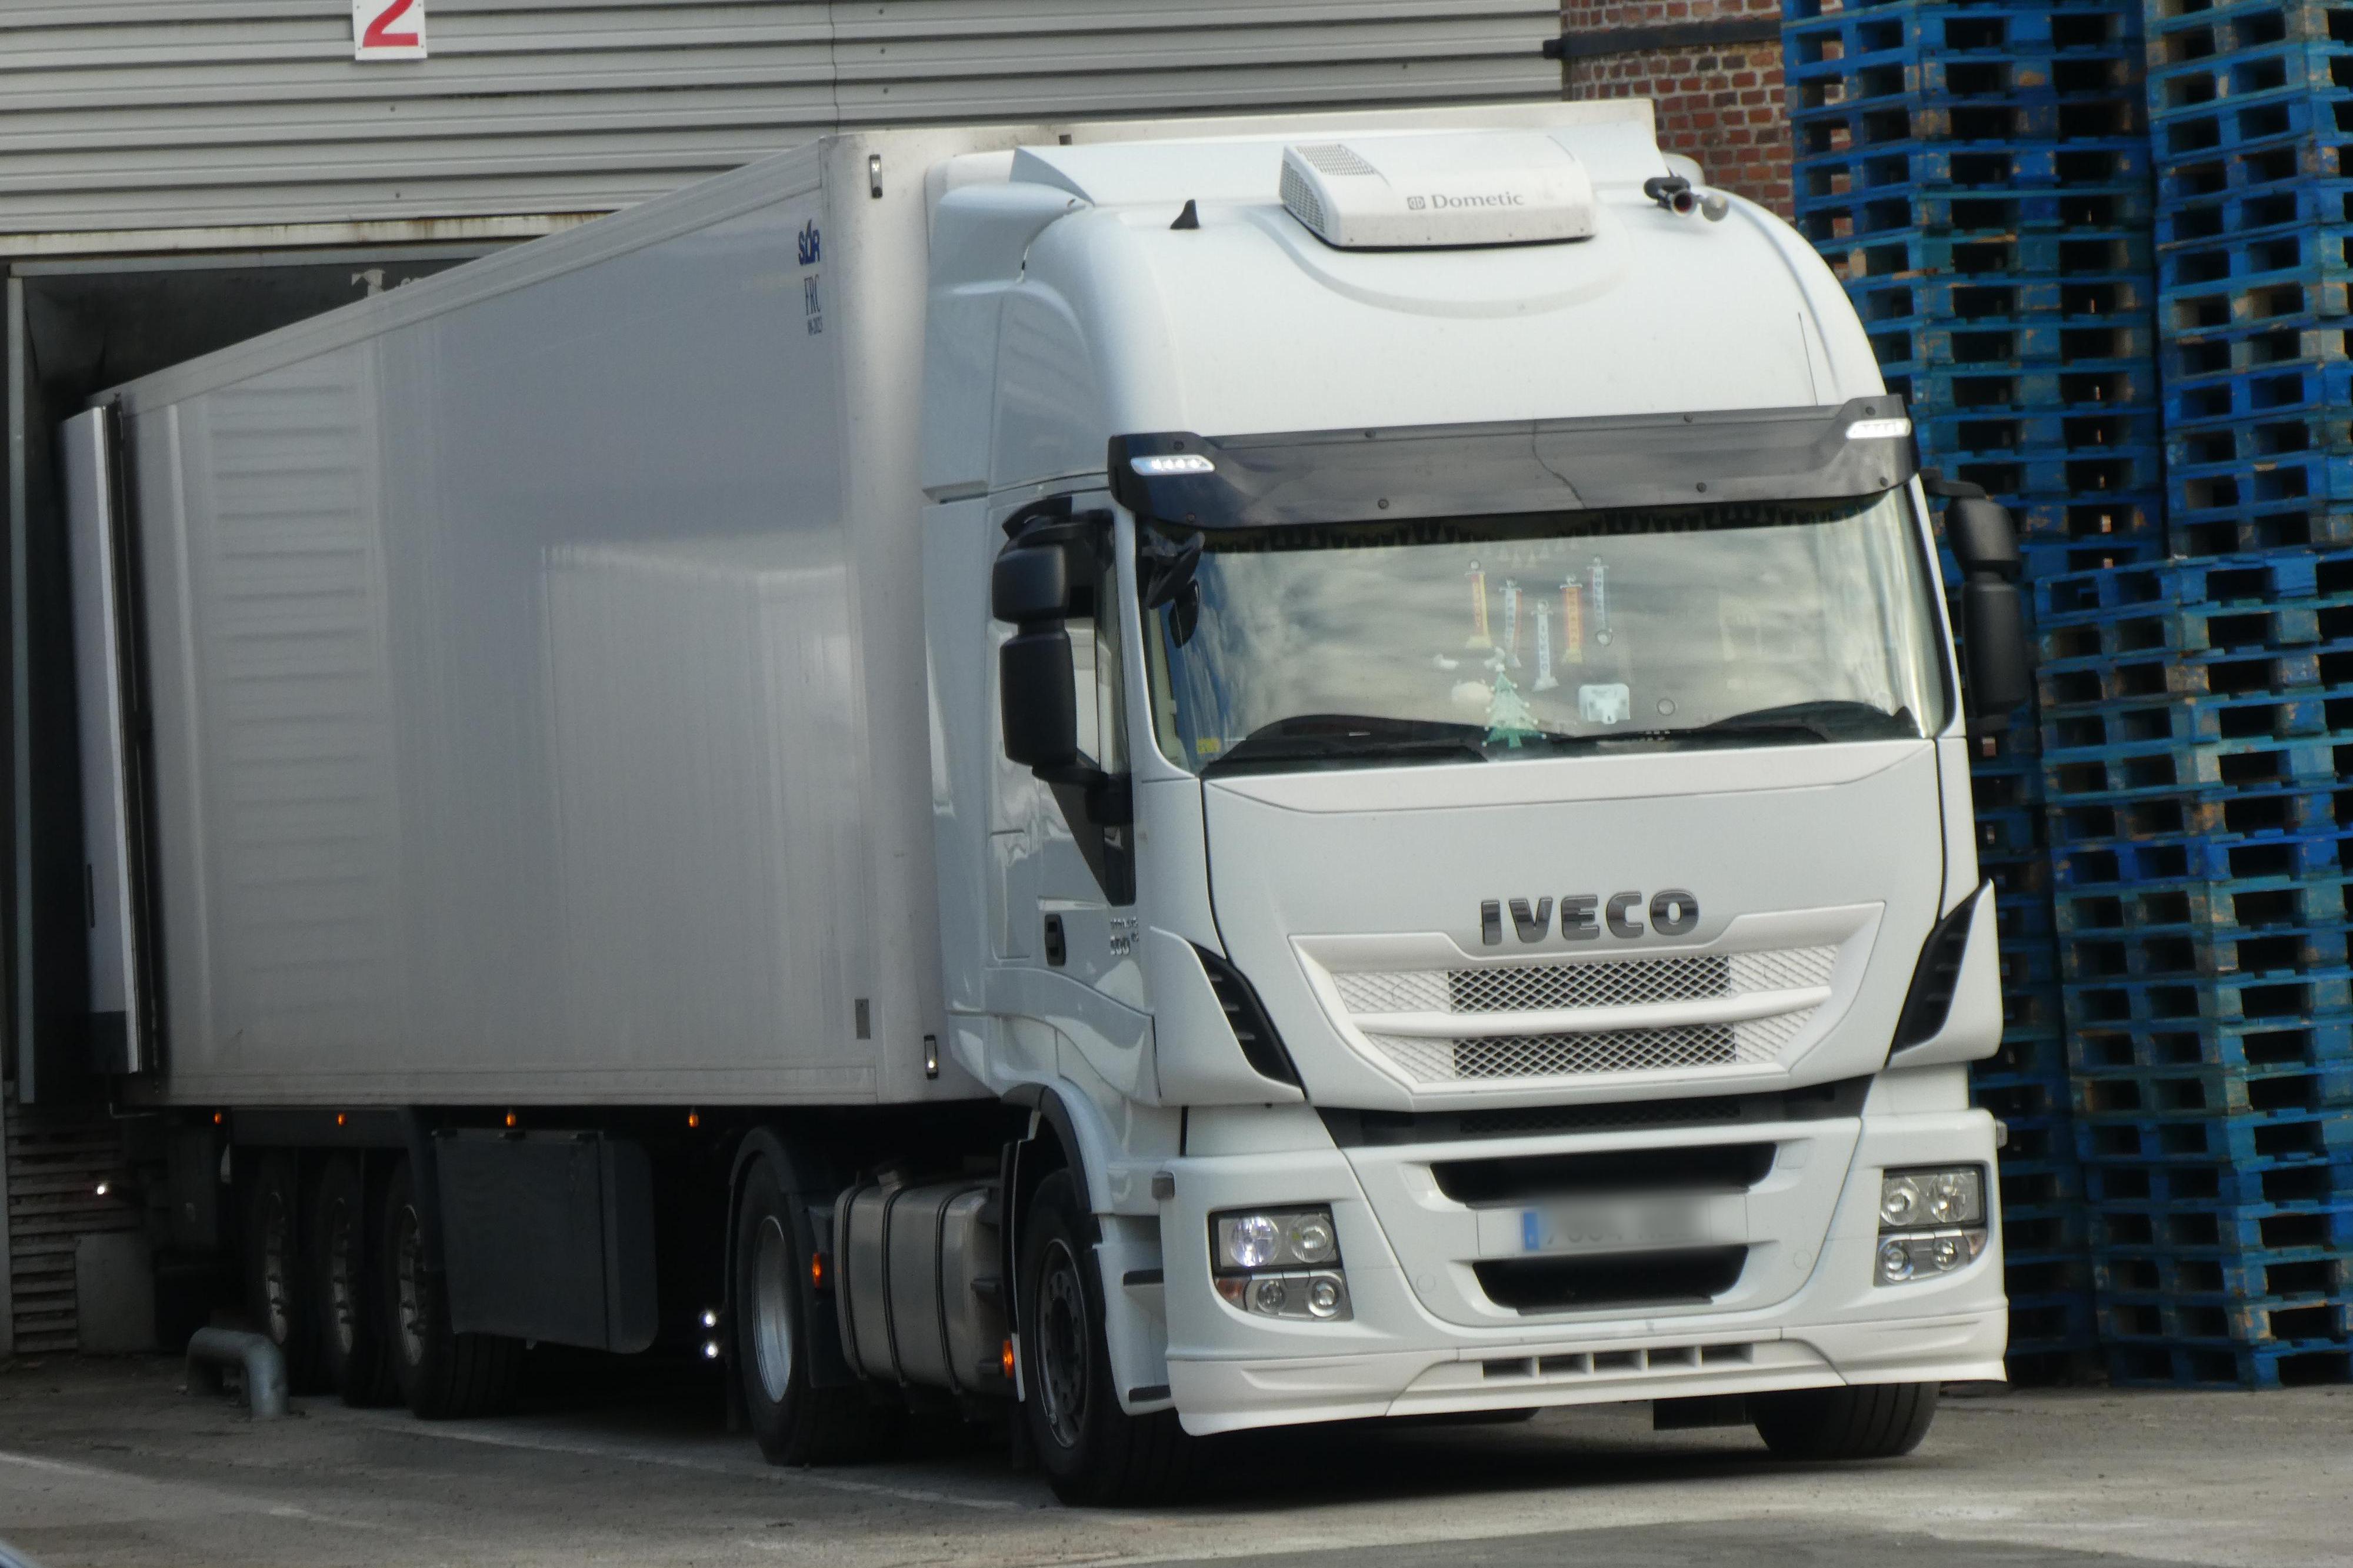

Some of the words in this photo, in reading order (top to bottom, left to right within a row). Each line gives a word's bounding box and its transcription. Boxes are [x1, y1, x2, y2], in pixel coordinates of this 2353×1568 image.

[362, 0, 419, 48] 2
[1431, 191, 1525, 209] Dometic
[804, 274, 821, 316] FRC
[1480, 888, 1699, 946] IVECO
